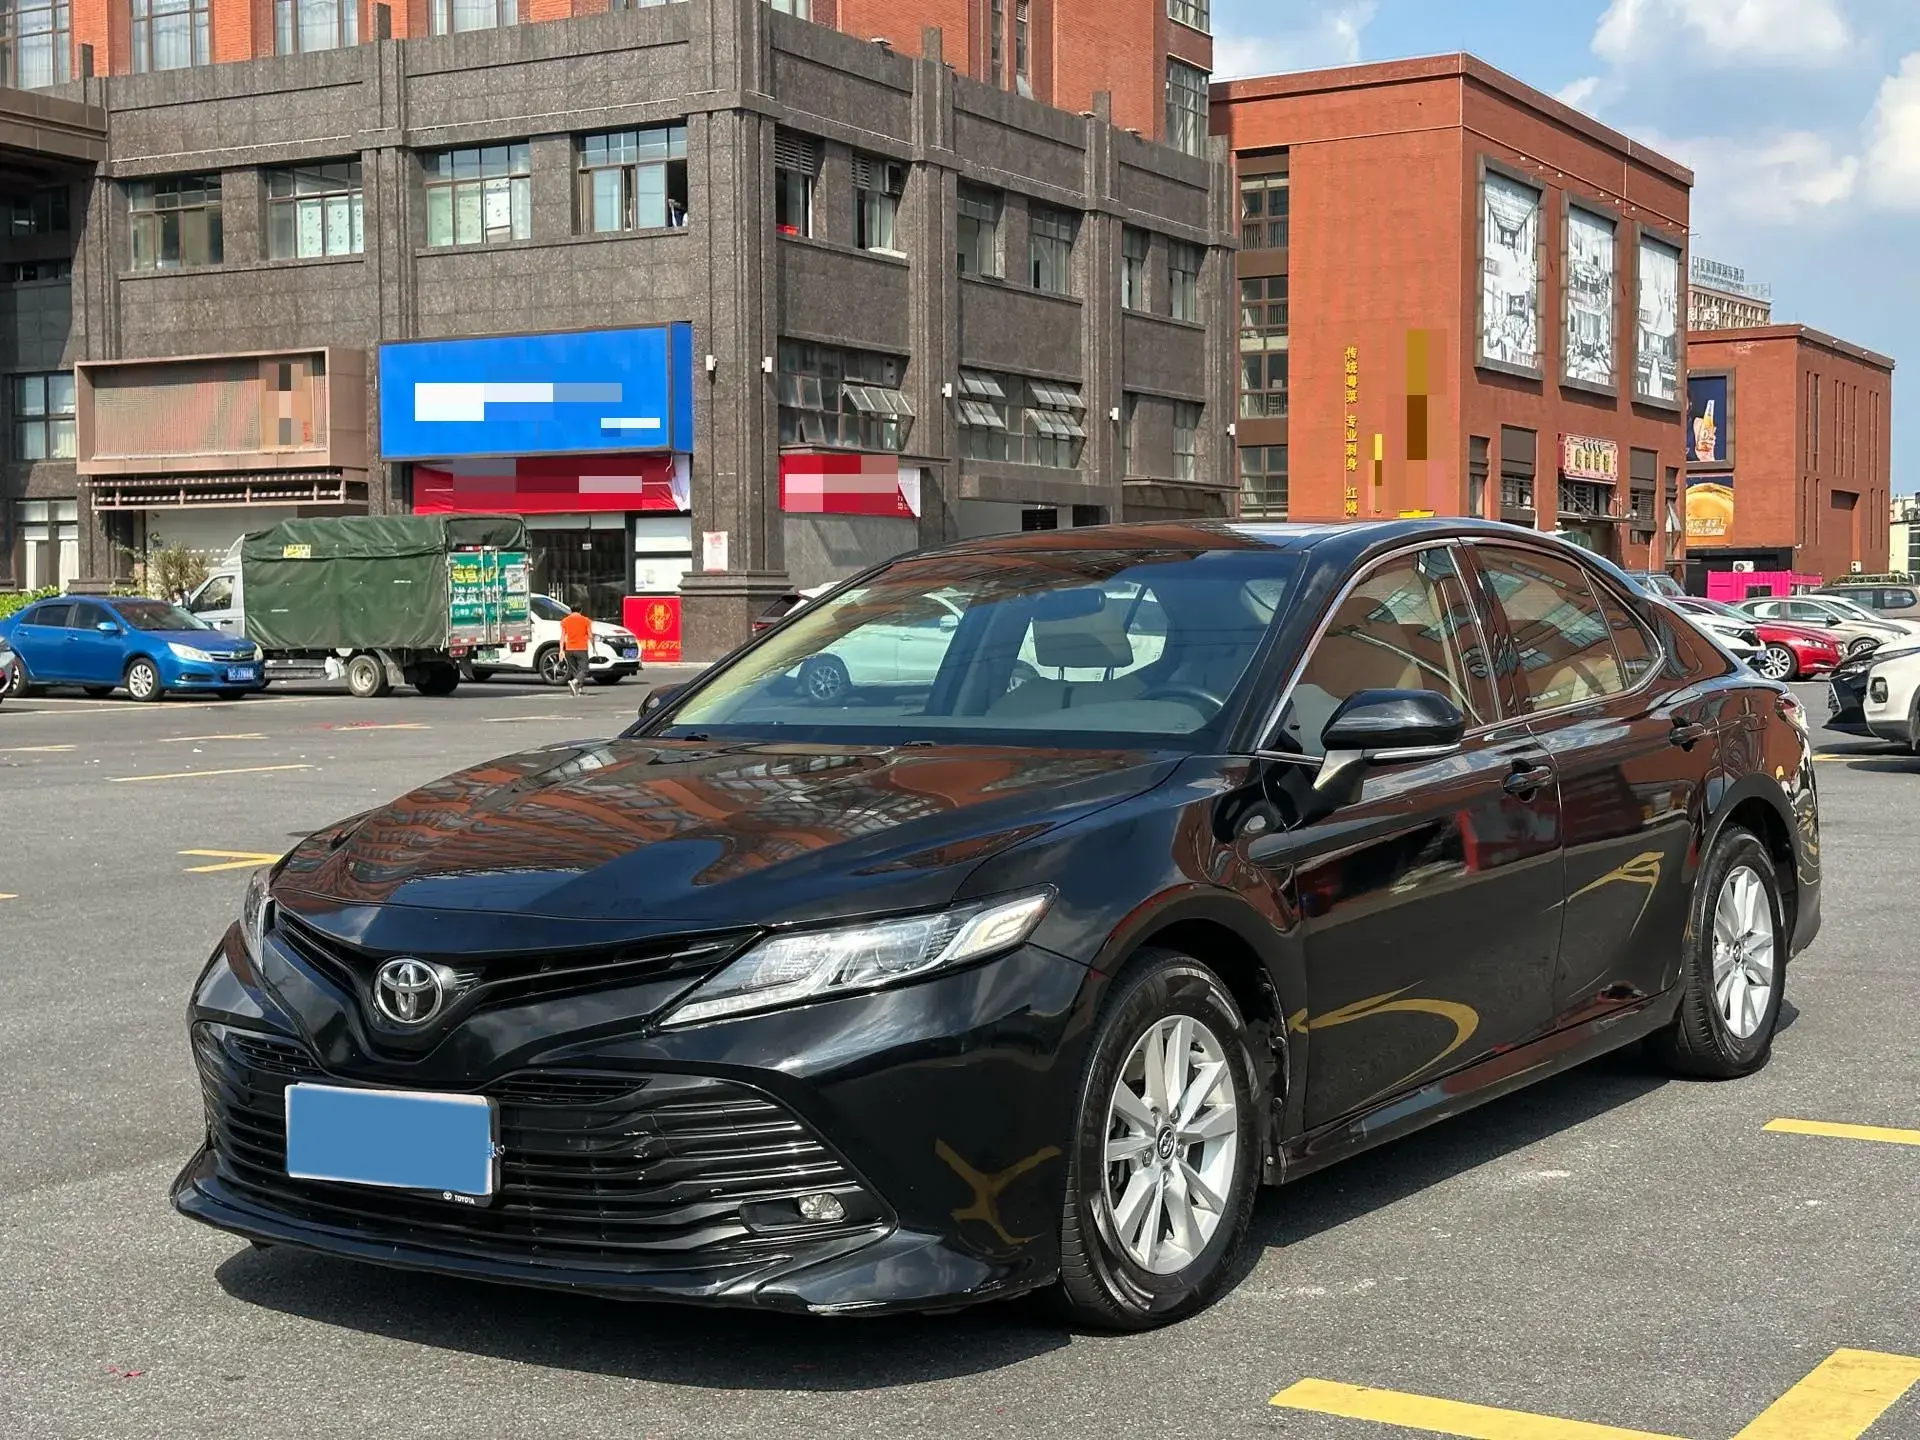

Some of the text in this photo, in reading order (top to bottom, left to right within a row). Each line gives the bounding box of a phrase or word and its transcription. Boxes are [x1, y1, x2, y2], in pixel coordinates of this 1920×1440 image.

[1345, 346, 1358, 403] 传统粤菜
[1345, 415, 1358, 471] 专业刺身
[454, 1194, 475, 1204] TOYOTA
